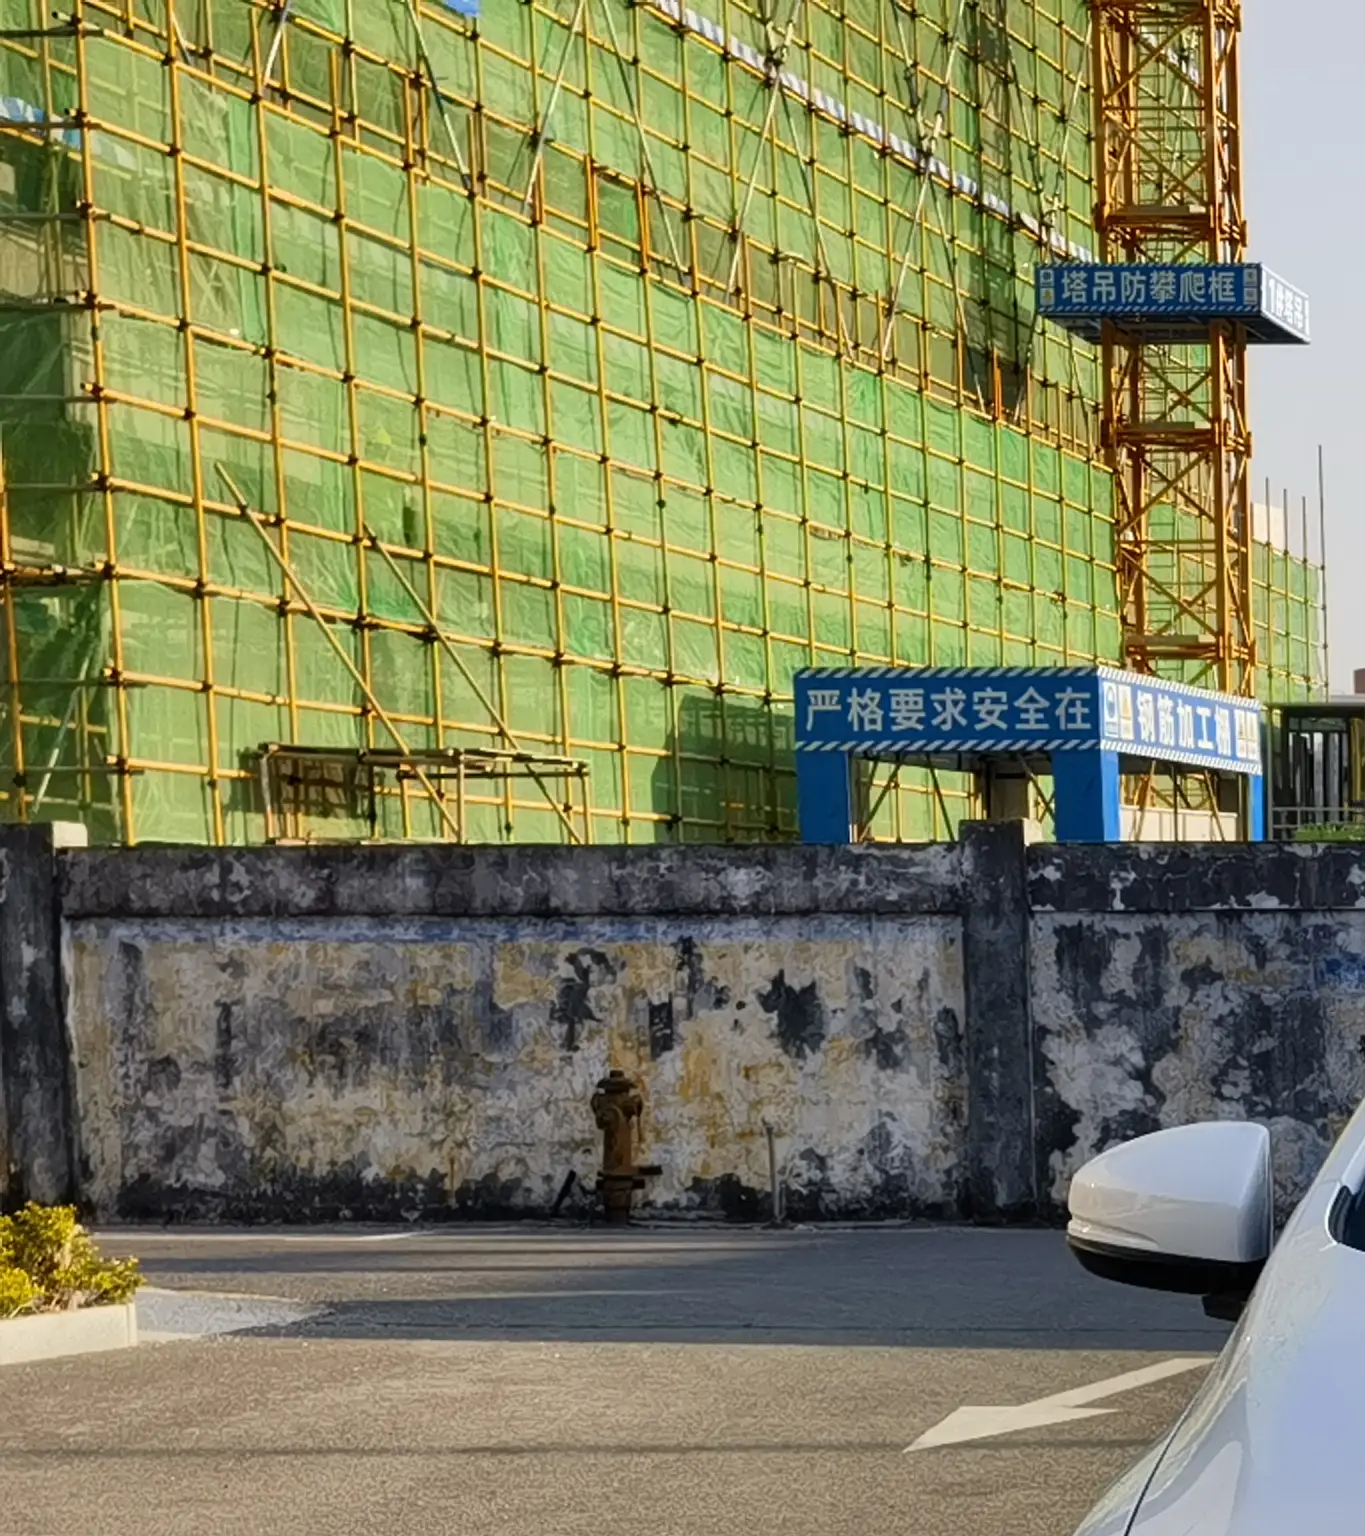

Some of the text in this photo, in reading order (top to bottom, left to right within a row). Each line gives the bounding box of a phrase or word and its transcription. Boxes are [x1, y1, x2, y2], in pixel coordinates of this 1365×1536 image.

[1061, 270, 1236, 304] 塔吊防攀爬框
[805, 686, 1093, 732] 严格要求安全在
